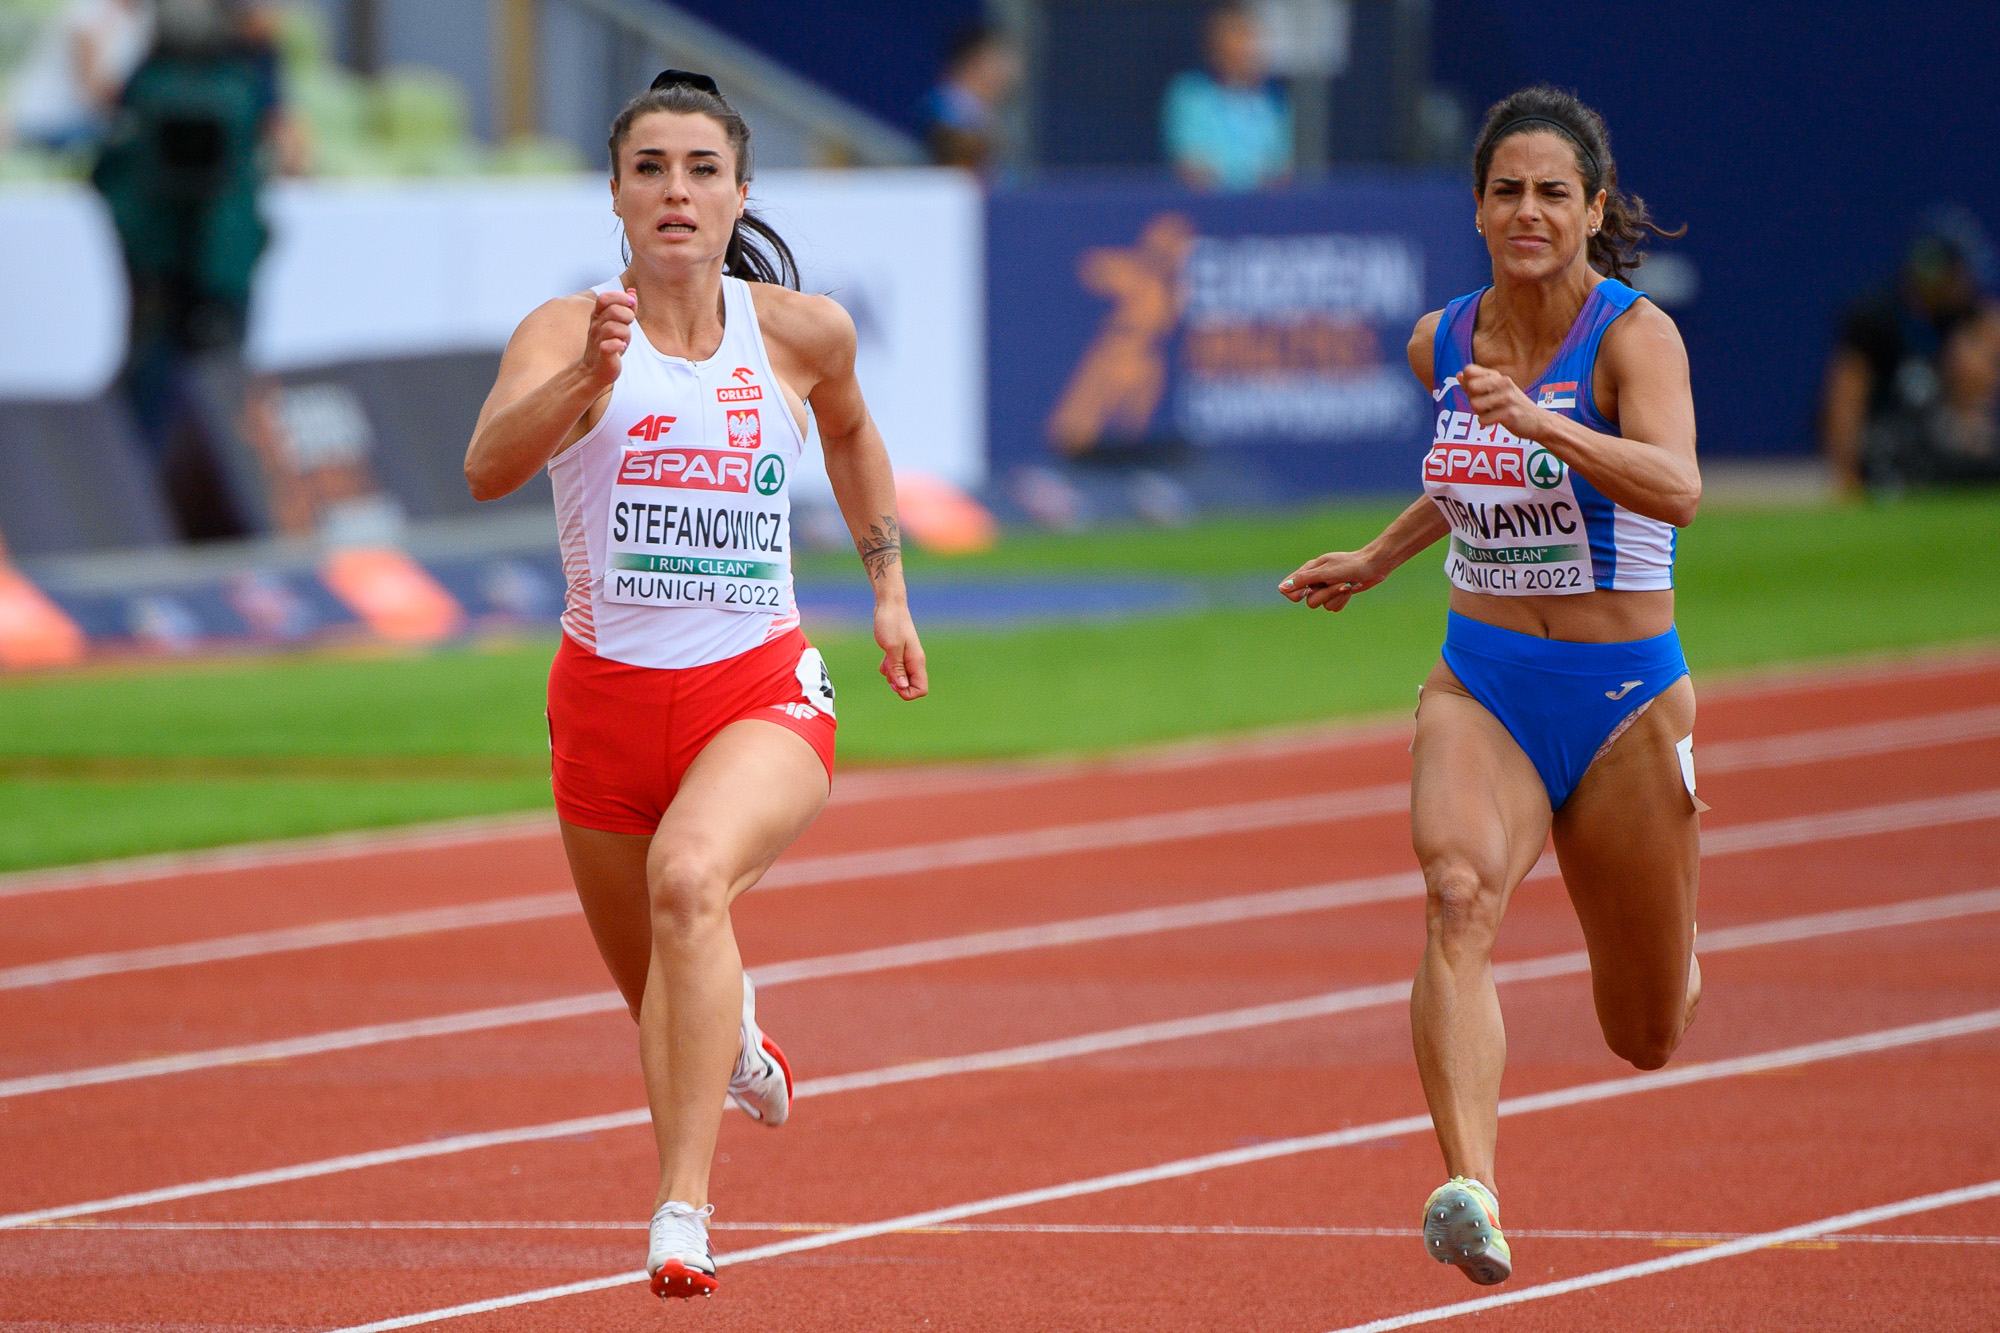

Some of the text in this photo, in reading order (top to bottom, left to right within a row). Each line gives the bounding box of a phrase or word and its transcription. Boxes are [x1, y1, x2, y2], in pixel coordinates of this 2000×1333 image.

[718, 386, 761, 401] ORLEN
[628, 414, 677, 441] 4F
[622, 453, 749, 488] SPAR
[1428, 448, 1522, 481] SPAR
[613, 501, 783, 553] STEFANOWICZ
[1433, 496, 1577, 539] TIRNANIC
[659, 557, 694, 572] RUN
[1468, 548, 1494, 561] RUN
[1451, 559, 1582, 589] MUNICH 2022
[616, 576, 780, 606] MUNICH 2022
